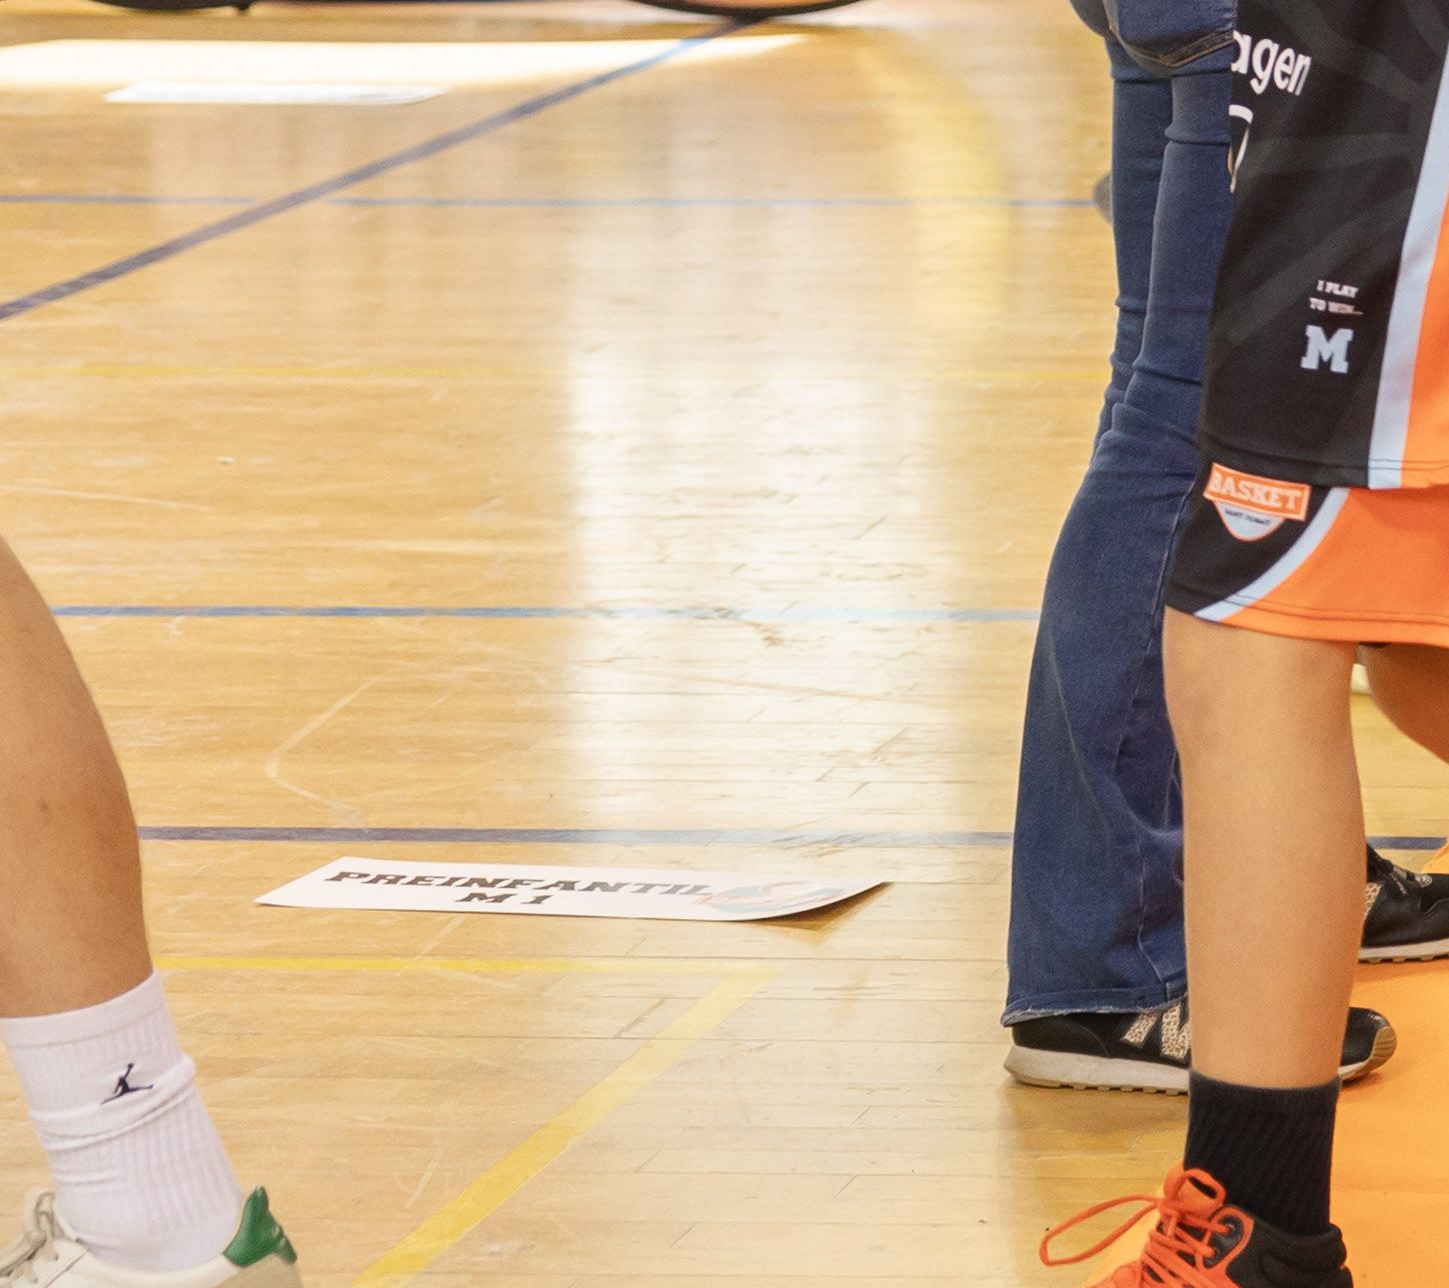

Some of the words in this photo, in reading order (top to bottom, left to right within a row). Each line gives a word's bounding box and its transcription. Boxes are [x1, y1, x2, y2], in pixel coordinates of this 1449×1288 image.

[1231, 28, 1313, 97] agen
[1299, 324, 1355, 375] M
[324, 870, 714, 897] PREINFANTIL
